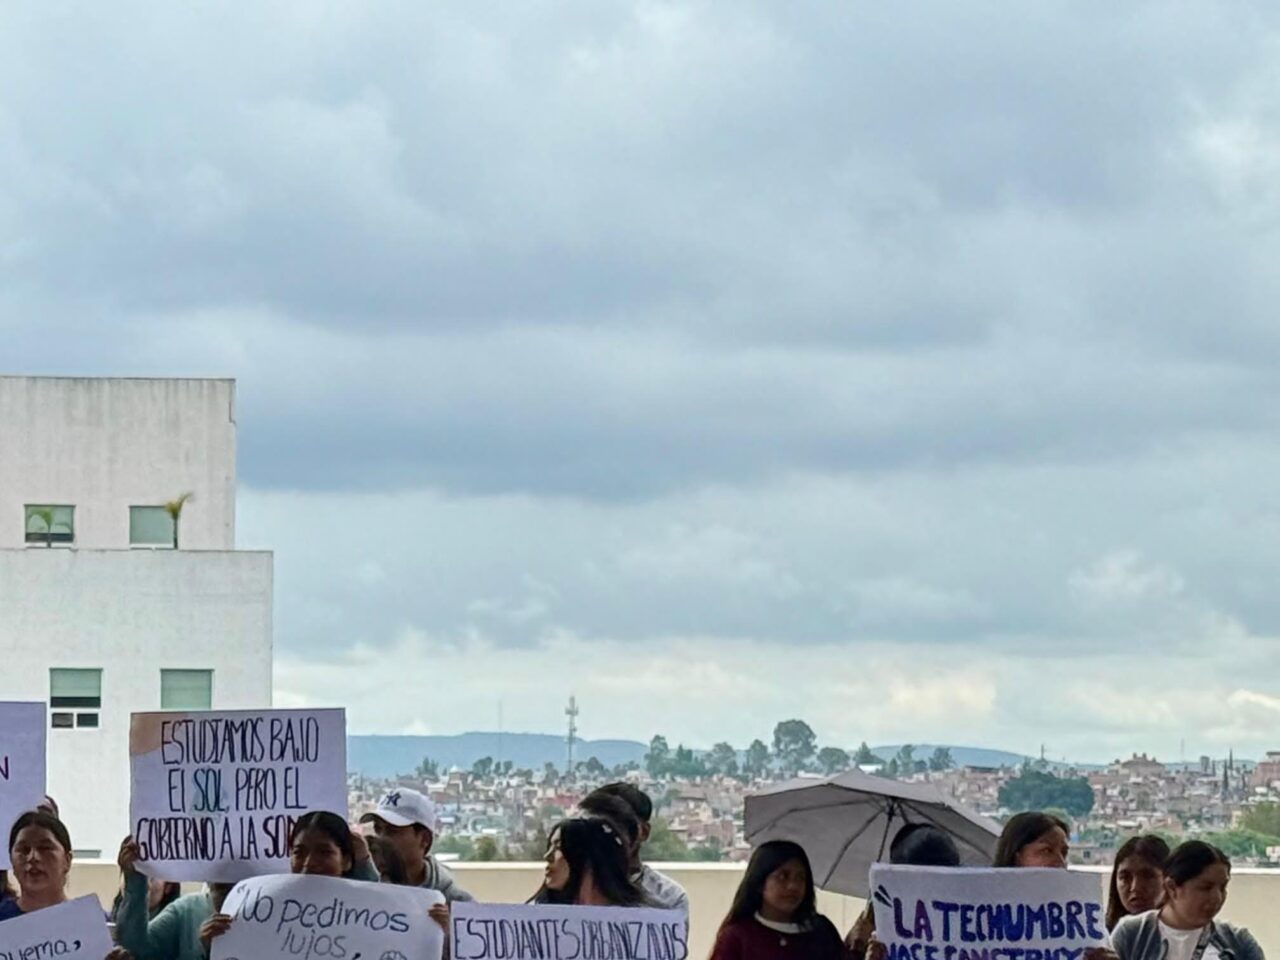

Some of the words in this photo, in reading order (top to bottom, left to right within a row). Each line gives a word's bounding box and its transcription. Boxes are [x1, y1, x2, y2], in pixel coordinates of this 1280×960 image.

[161, 717, 265, 765] ESTUDIAMOS
[270, 716, 319, 763] BAJO
[235, 767, 277, 811] PERO
[284, 766, 308, 809] EL
[135, 817, 216, 861] GOBIERNO
[220, 816, 234, 860] A
[239, 815, 259, 860] LA
[276, 898, 410, 933] pedimos
[932, 899, 1104, 942] TECHUMBRE
[453, 917, 580, 960] ESTUDIANTES
